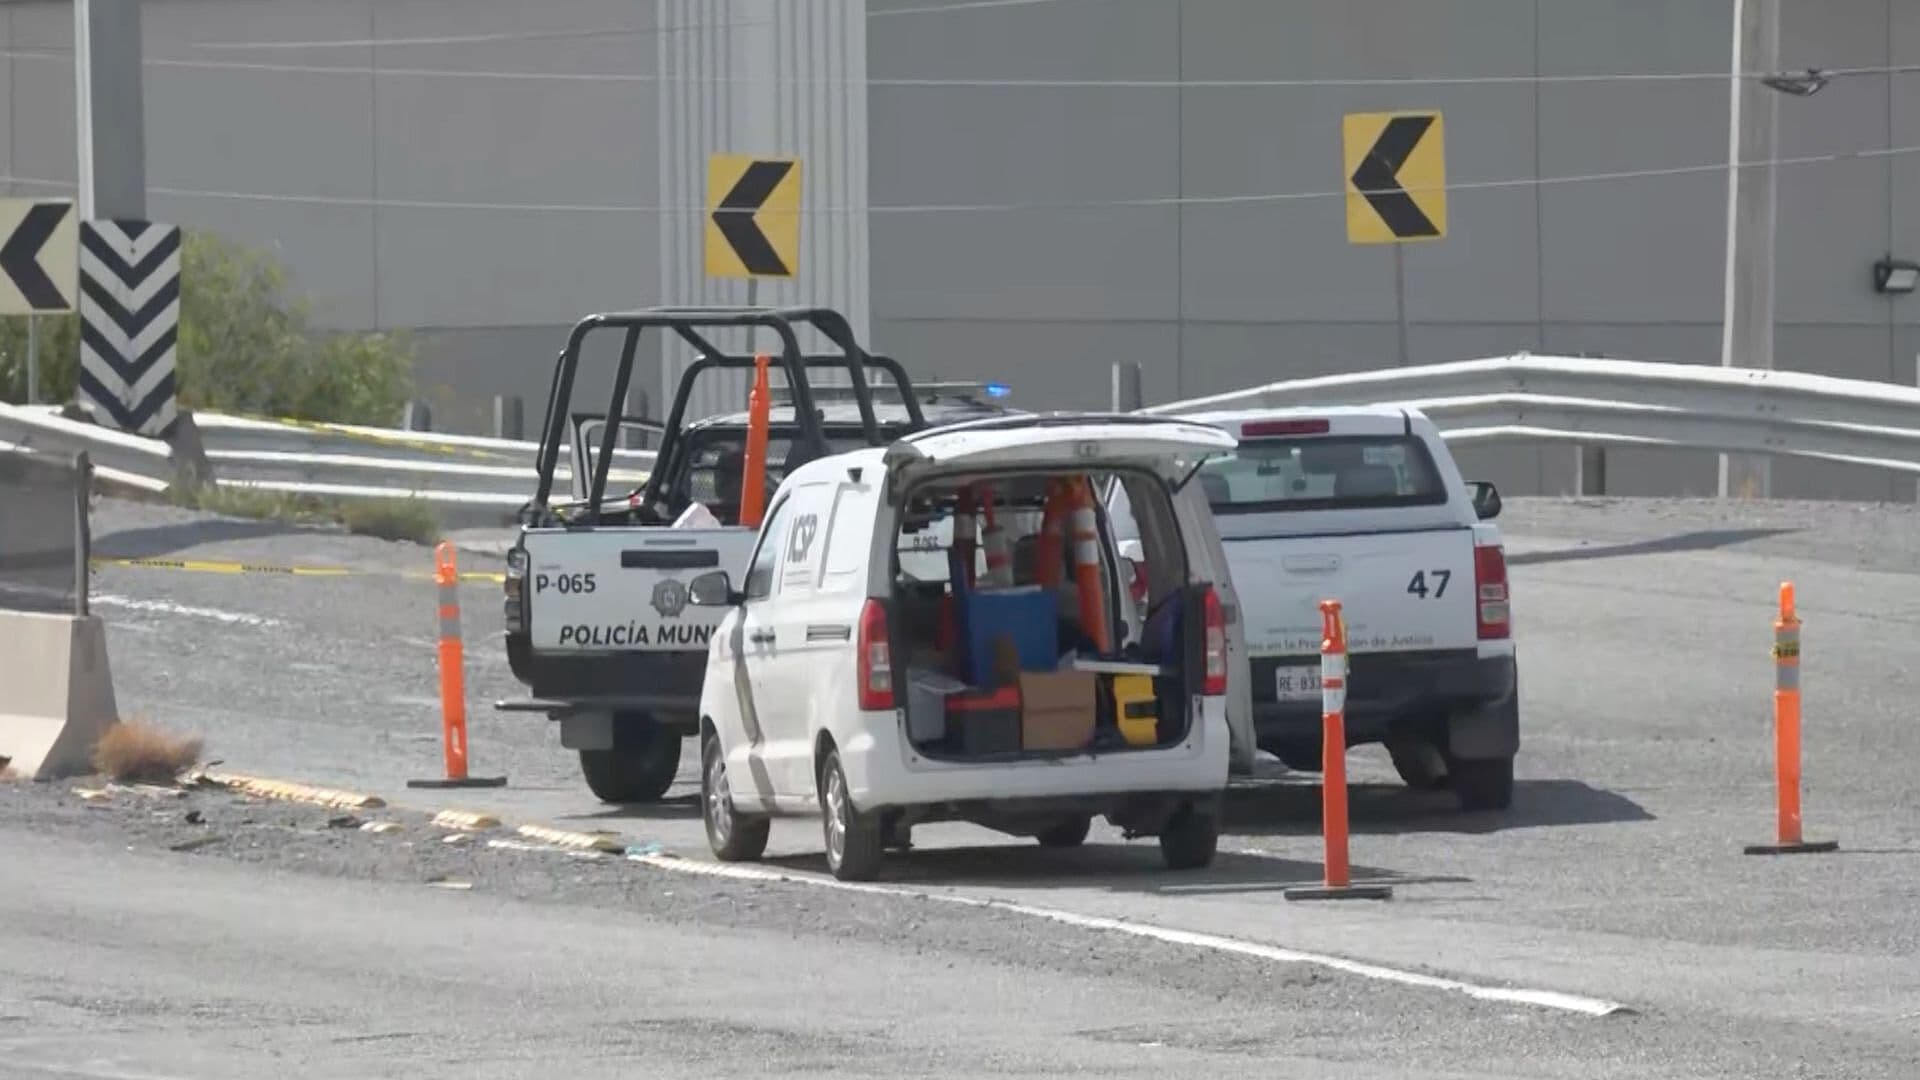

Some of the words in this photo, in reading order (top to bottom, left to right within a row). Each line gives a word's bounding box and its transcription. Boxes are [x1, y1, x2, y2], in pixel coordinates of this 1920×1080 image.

[536, 573, 596, 594] P-065
[1407, 570, 1451, 598] 47
[559, 619, 649, 645] POLICÍA
